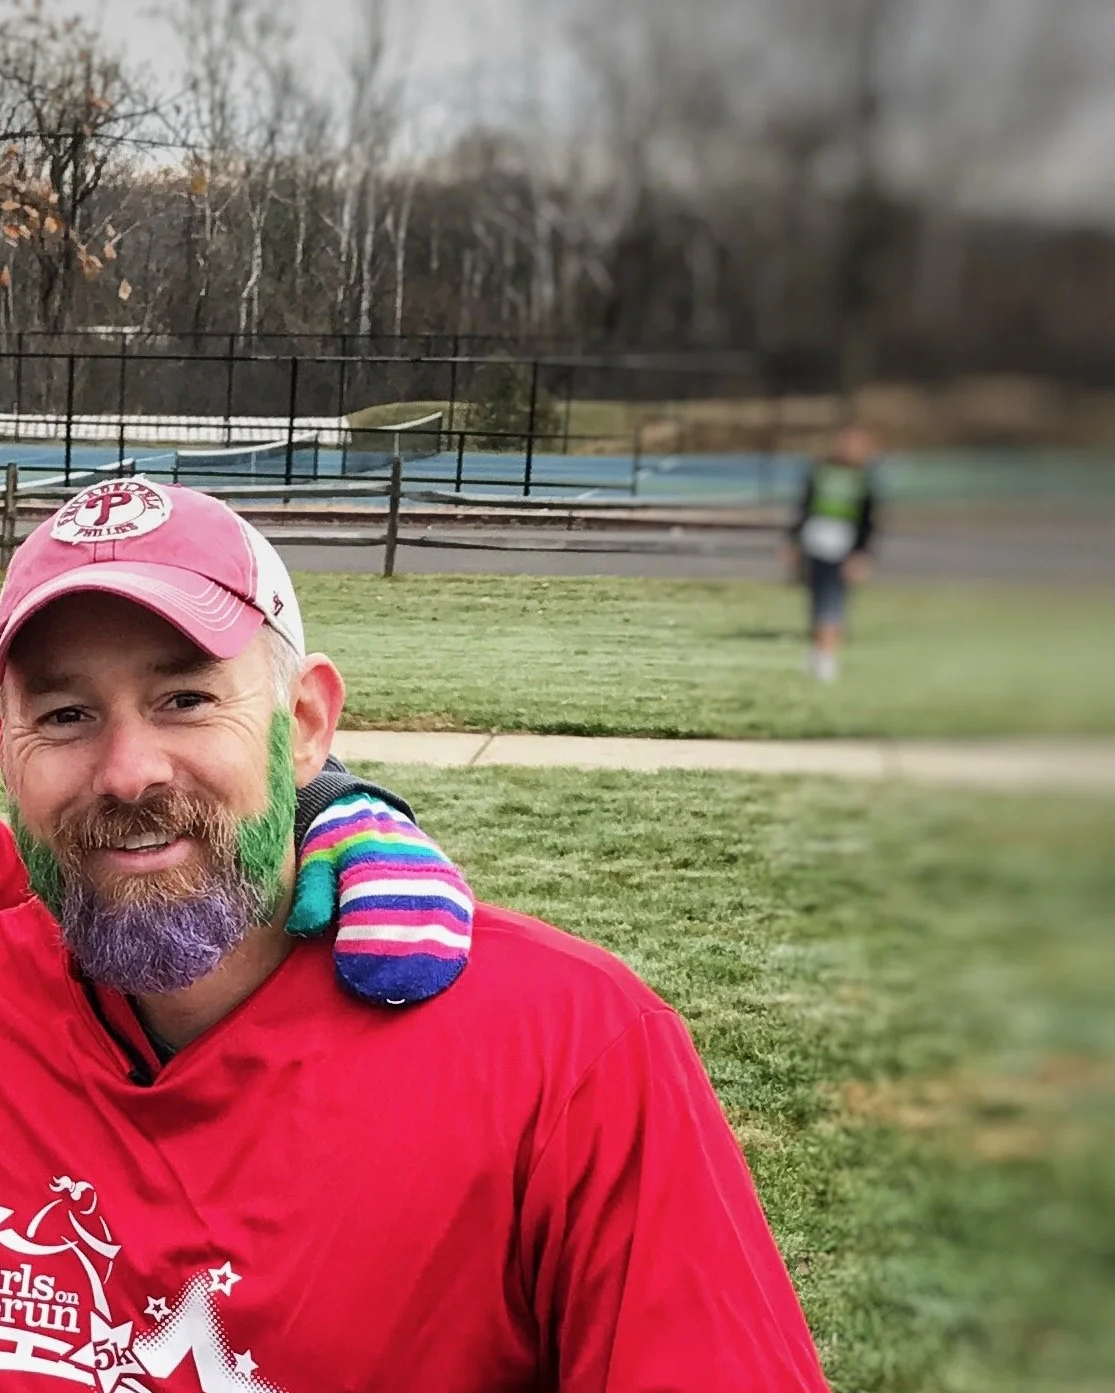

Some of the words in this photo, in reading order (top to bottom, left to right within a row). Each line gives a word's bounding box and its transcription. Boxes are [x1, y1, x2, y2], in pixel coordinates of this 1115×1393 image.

[73, 522, 138, 537] PHILLIES
[55, 1290, 80, 1306] on
[0, 1298, 81, 1334] run
[92, 1337, 134, 1371] 5k
